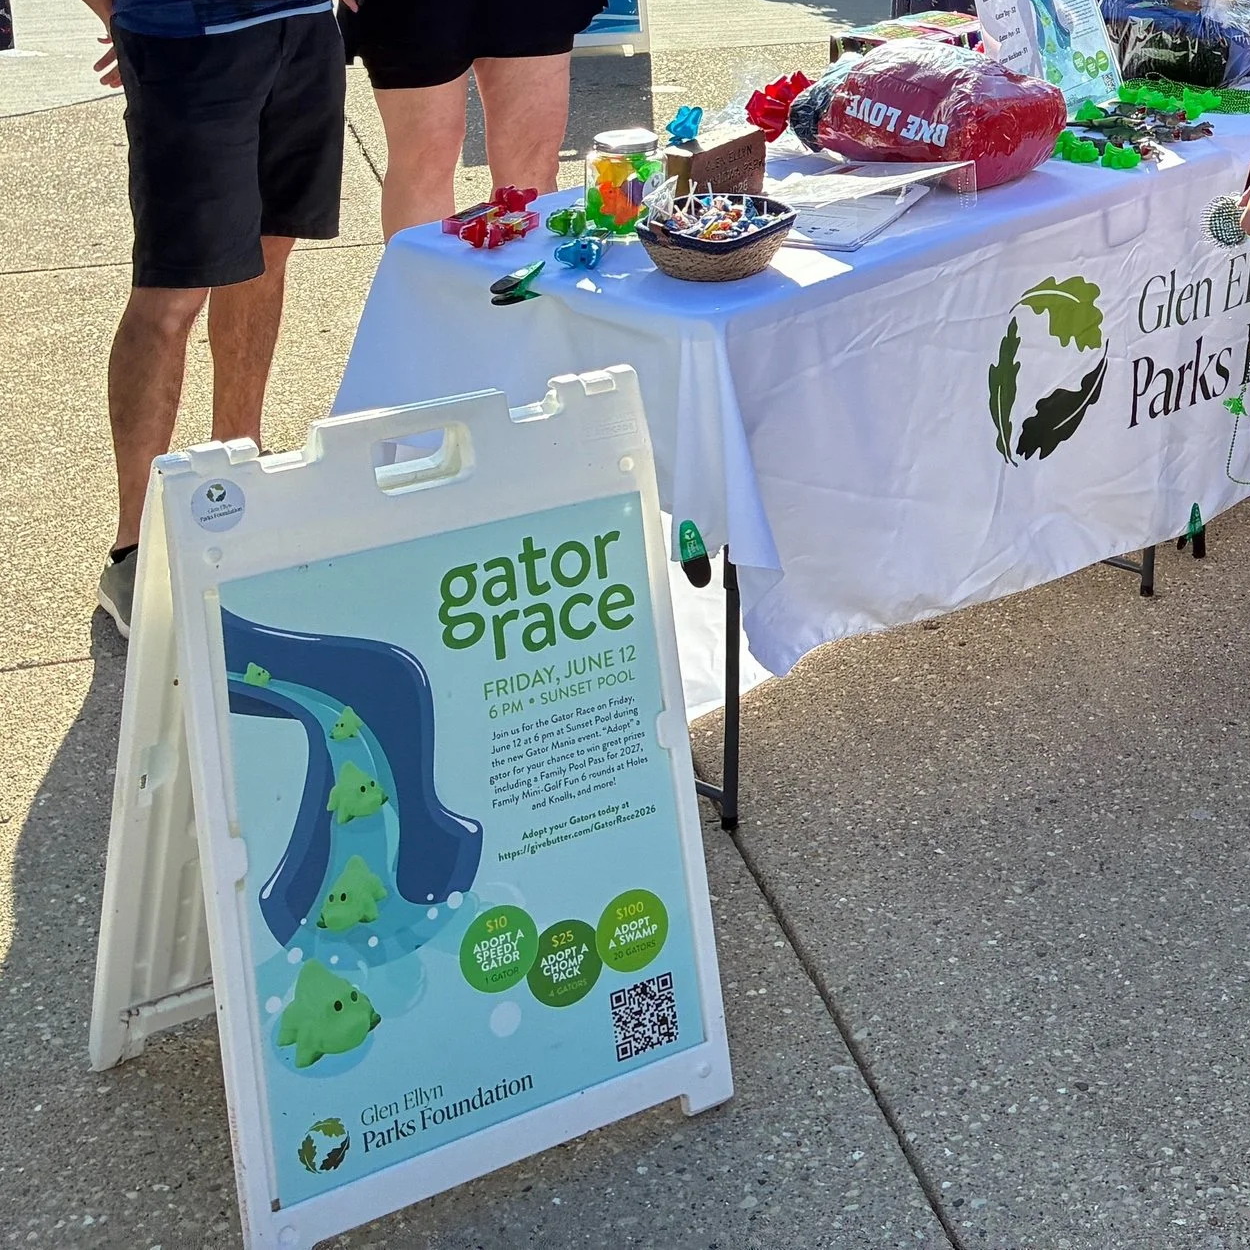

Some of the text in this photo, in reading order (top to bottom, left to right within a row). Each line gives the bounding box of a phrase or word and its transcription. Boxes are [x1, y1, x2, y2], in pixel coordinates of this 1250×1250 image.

[845, 95, 949, 148] ONE LOVE
[1138, 269, 1213, 334] Glen
[1127, 336, 1232, 429] Parks
[438, 530, 620, 650] gator
[492, 584, 635, 660] race
[483, 645, 637, 700] FRIDAY, JUNE 12
[489, 669, 635, 719] 6 PM SUNSET POOL
[491, 744, 511, 755] June
[523, 737, 532, 745] at
[534, 733, 540, 741] 6
[541, 731, 555, 743] pm
[556, 728, 564, 736] at
[566, 720, 593, 733] Sunset
[595, 713, 612, 725] Pool
[613, 707, 638, 720] during
[492, 696, 635, 741] Join us for the Gator Race on Friday,
[489, 770, 511, 785] gator
[512, 765, 525, 776] for
[526, 760, 545, 773] your
[547, 752, 575, 765] chance
[587, 745, 600, 753] win
[602, 737, 622, 752] great
[623, 731, 645, 745] prizes
[491, 759, 505, 768] the
[508, 754, 524, 763] new
[525, 745, 549, 759] Gator
[551, 737, 576, 751] Mania
[578, 732, 602, 743] event.
[603, 718, 634, 735] “Adopt”
[492, 793, 520, 809] Family
[522, 778, 562, 800] Mini-Golf
[564, 775, 579, 786] Fun
[581, 773, 587, 781] 6
[589, 766, 615, 779] rounds
[626, 756, 648, 768] Holes
[494, 777, 532, 795] including
[540, 766, 567, 781] Family
[569, 761, 586, 772] Pool
[588, 756, 605, 766] Pass
[607, 751, 618, 760] for
[620, 744, 644, 757] 2027,
[531, 777, 617, 811] and Knolls, and more!
[498, 805, 656, 862] https://givebutter.com/GatorRace2026
[522, 801, 629, 841] Adopt your Gators today at
[485, 915, 508, 933] $10
[614, 916, 650, 938] ADOPT
[616, 901, 644, 920] $100
[473, 929, 525, 954] ADOPT A
[476, 942, 518, 964] SPEEDY
[540, 943, 589, 968] ADOPT A
[551, 930, 574, 948] $25
[608, 924, 658, 950] A SWAMP
[614, 941, 657, 961] 20 GATORS
[481, 951, 520, 972] GATOR
[491, 967, 519, 983] GATOR
[543, 955, 584, 976] CHOMP
[552, 967, 581, 984] PACK
[548, 979, 588, 997] 4 GATORS
[361, 1085, 444, 1127] Glen Ellyn
[362, 1074, 534, 1153] Parks Foundation
